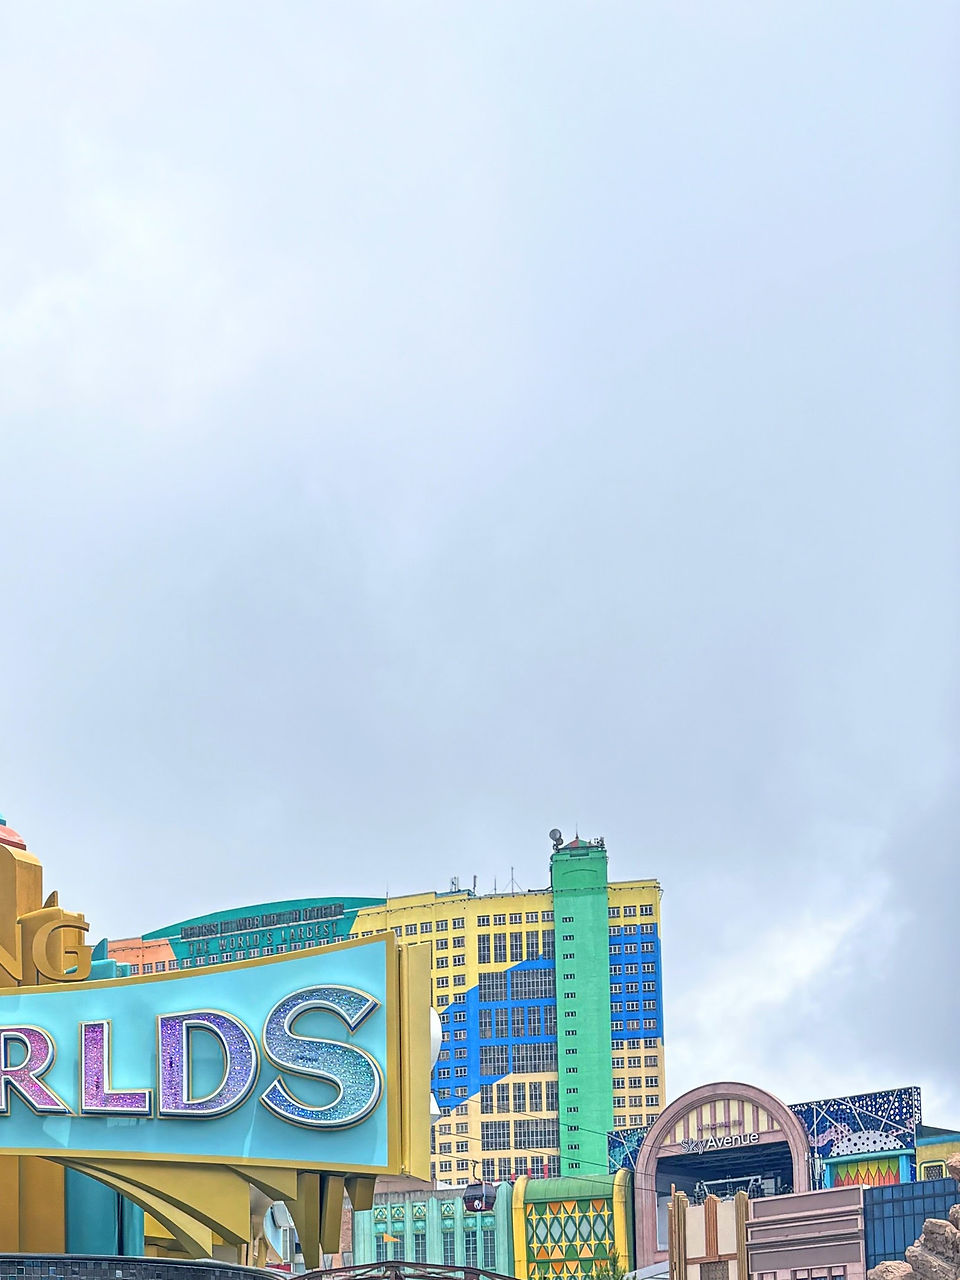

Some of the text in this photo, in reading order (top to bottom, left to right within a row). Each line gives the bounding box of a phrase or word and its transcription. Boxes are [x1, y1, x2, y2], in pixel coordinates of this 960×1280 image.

[189, 922, 338, 955] THE WORLD'S LARGEST
[680, 1133, 759, 1155] SkyAvenue
